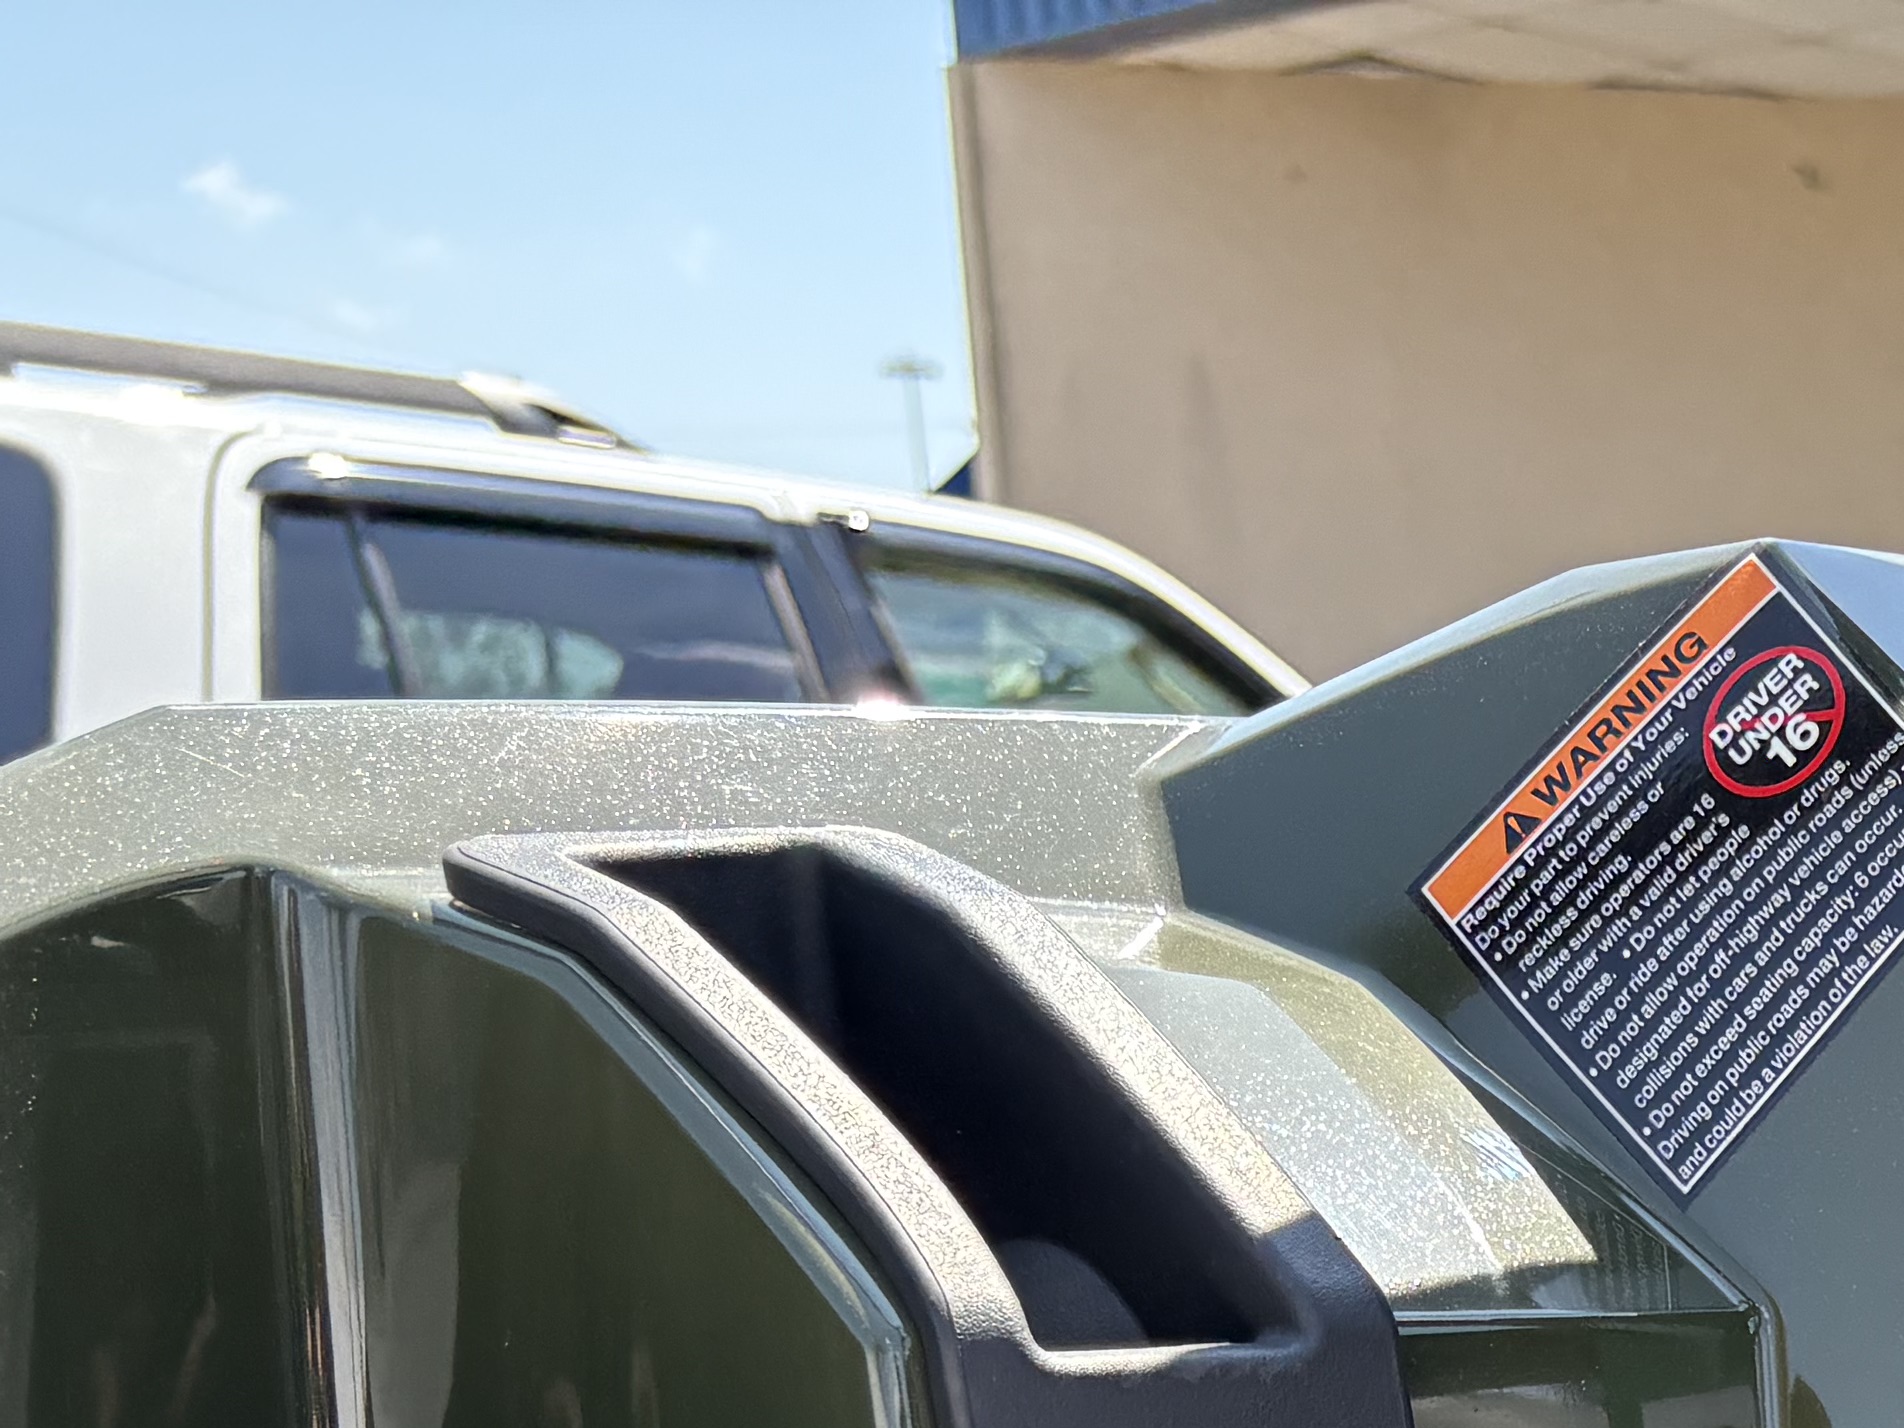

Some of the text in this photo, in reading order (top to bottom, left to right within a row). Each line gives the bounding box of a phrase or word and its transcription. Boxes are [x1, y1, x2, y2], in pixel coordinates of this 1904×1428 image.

[1460, 647, 1737, 934] Require Proper Use of Your Vehicle
[1530, 631, 1709, 807] WARNING
[1708, 651, 1805, 750] DRIVER
[1727, 672, 1820, 765] UNDER
[1766, 705, 1820, 768] 16
[1474, 726, 1690, 951] Do your part to prevent injuries:
[1501, 780, 1665, 955] Do not allow careless or
[1518, 854, 1632, 973] reckless driving.
[1527, 792, 1716, 994] Make sure operators are 16
[1546, 813, 1730, 1011] or older with a valid driver's
[1580, 759, 1851, 1050] drive or ride after using alcohol or drugs.
[1594, 1043, 1621, 1071] Do
[1617, 1012, 1645, 1047] not
[1640, 971, 1679, 1019] allow
[1676, 899, 1745, 977] operation
[1742, 877, 1765, 902] on
[1762, 829, 1811, 884] public
[1808, 785, 1854, 833] roads
[1616, 995, 1692, 1089] designated
[1685, 973, 1711, 1003] for
[1708, 882, 1792, 979] off-highway
[1787, 830, 1844, 886] vehicle
[1841, 769, 1903, 833] access)
[1628, 824, 1751, 952] Do not let people
[1560, 972, 1617, 1031] license.
[1634, 804, 1903, 1109] collisions with cars and trucks can occur.
[1648, 1102, 1675, 1129] Do
[1670, 1072, 1699, 1106] not
[1694, 1012, 1747, 1078] exceed
[1743, 957, 1800, 1021] seating
[1793, 885, 1859, 961] capacity:
[1853, 871, 1870, 889] 6
[1656, 1101, 1713, 1160] Driving
[1706, 1079, 1730, 1105] on
[1725, 1030, 1771, 1088] public
[1766, 984, 1810, 1035] roads
[1805, 947, 1840, 989] may
[1832, 926, 1859, 953] be
[1678, 924, 1899, 1180] and could be a violation of the law.
